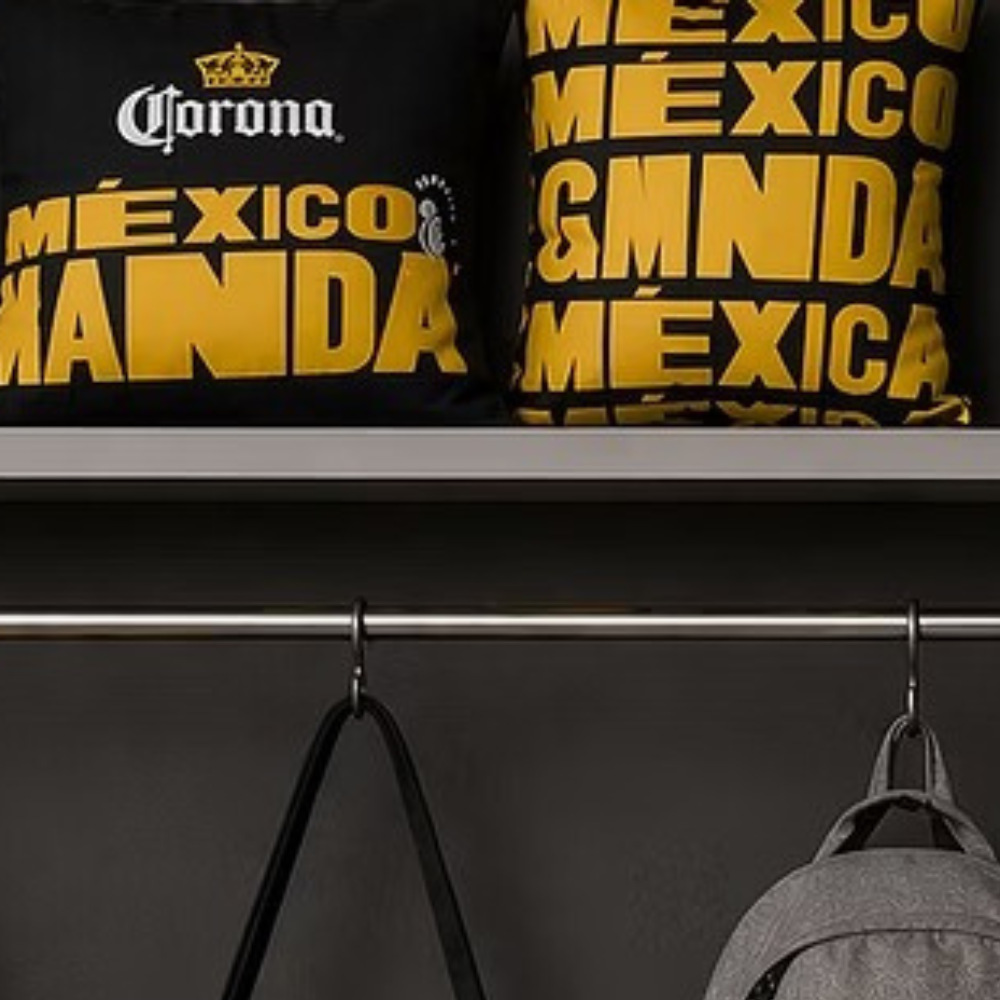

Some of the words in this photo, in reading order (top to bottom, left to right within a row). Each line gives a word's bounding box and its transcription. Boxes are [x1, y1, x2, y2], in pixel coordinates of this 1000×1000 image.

[116, 83, 336, 154] Corona
[531, 50, 959, 153] MÉXICO
[5, 178, 418, 265] MÉXICO
[519, 286, 950, 400] MÉXICA
